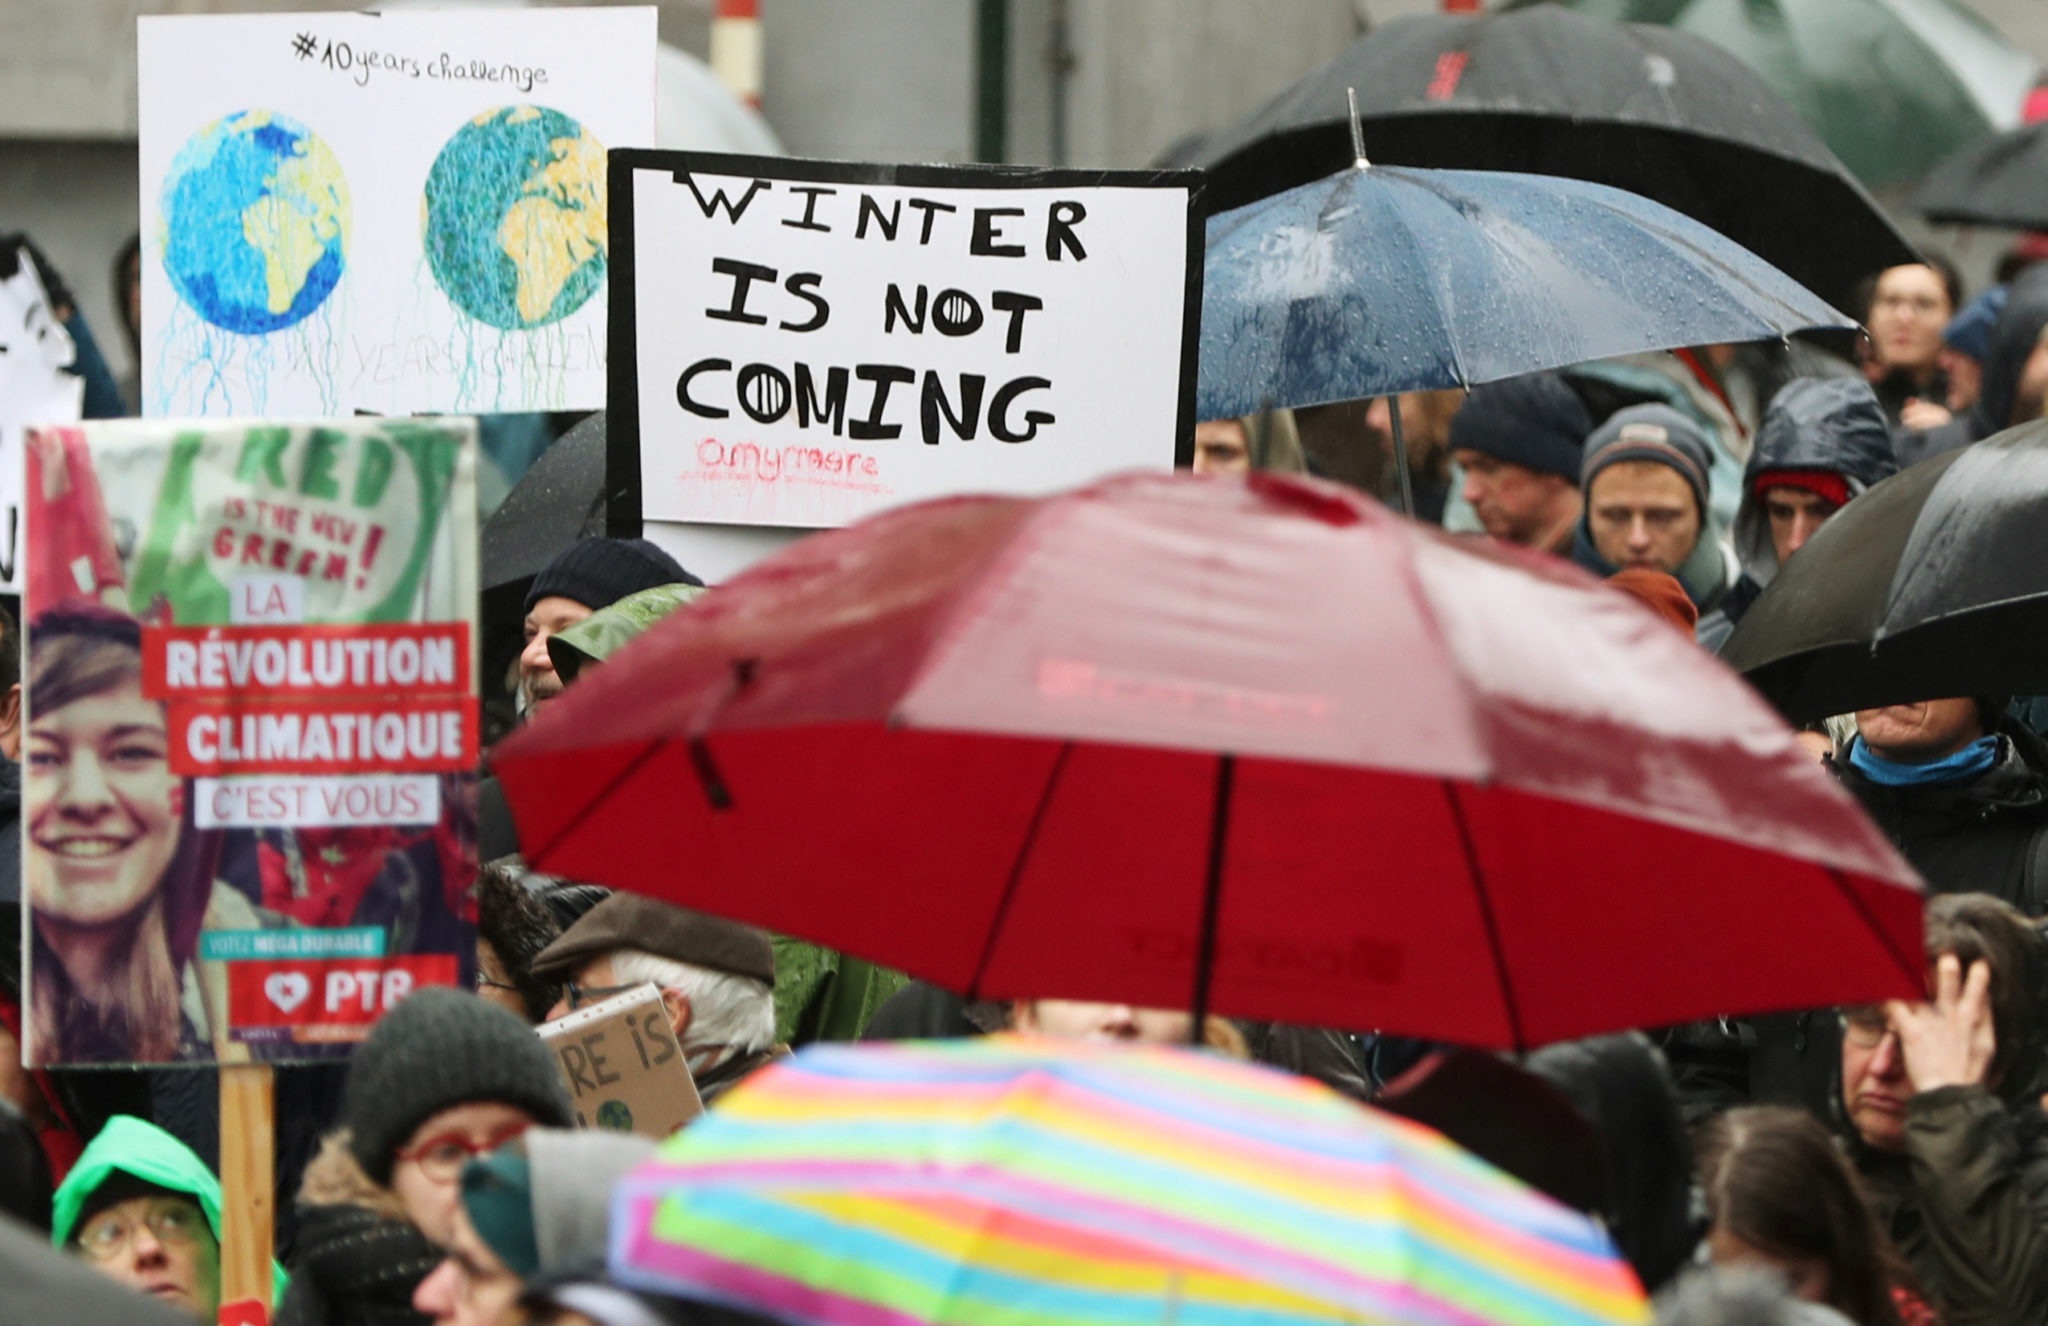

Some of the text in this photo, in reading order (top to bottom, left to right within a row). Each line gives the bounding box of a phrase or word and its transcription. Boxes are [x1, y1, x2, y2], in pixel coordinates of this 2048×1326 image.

[672, 170, 1088, 263] WINTER
[704, 257, 1044, 354] IS NOT
[676, 357, 1056, 446] COMING
[246, 583, 287, 616] LA
[165, 628, 456, 688] RÉVOLUTION
[186, 712, 463, 763] CLIMATIQUE
[212, 784, 420, 820] C'EST VOUS
